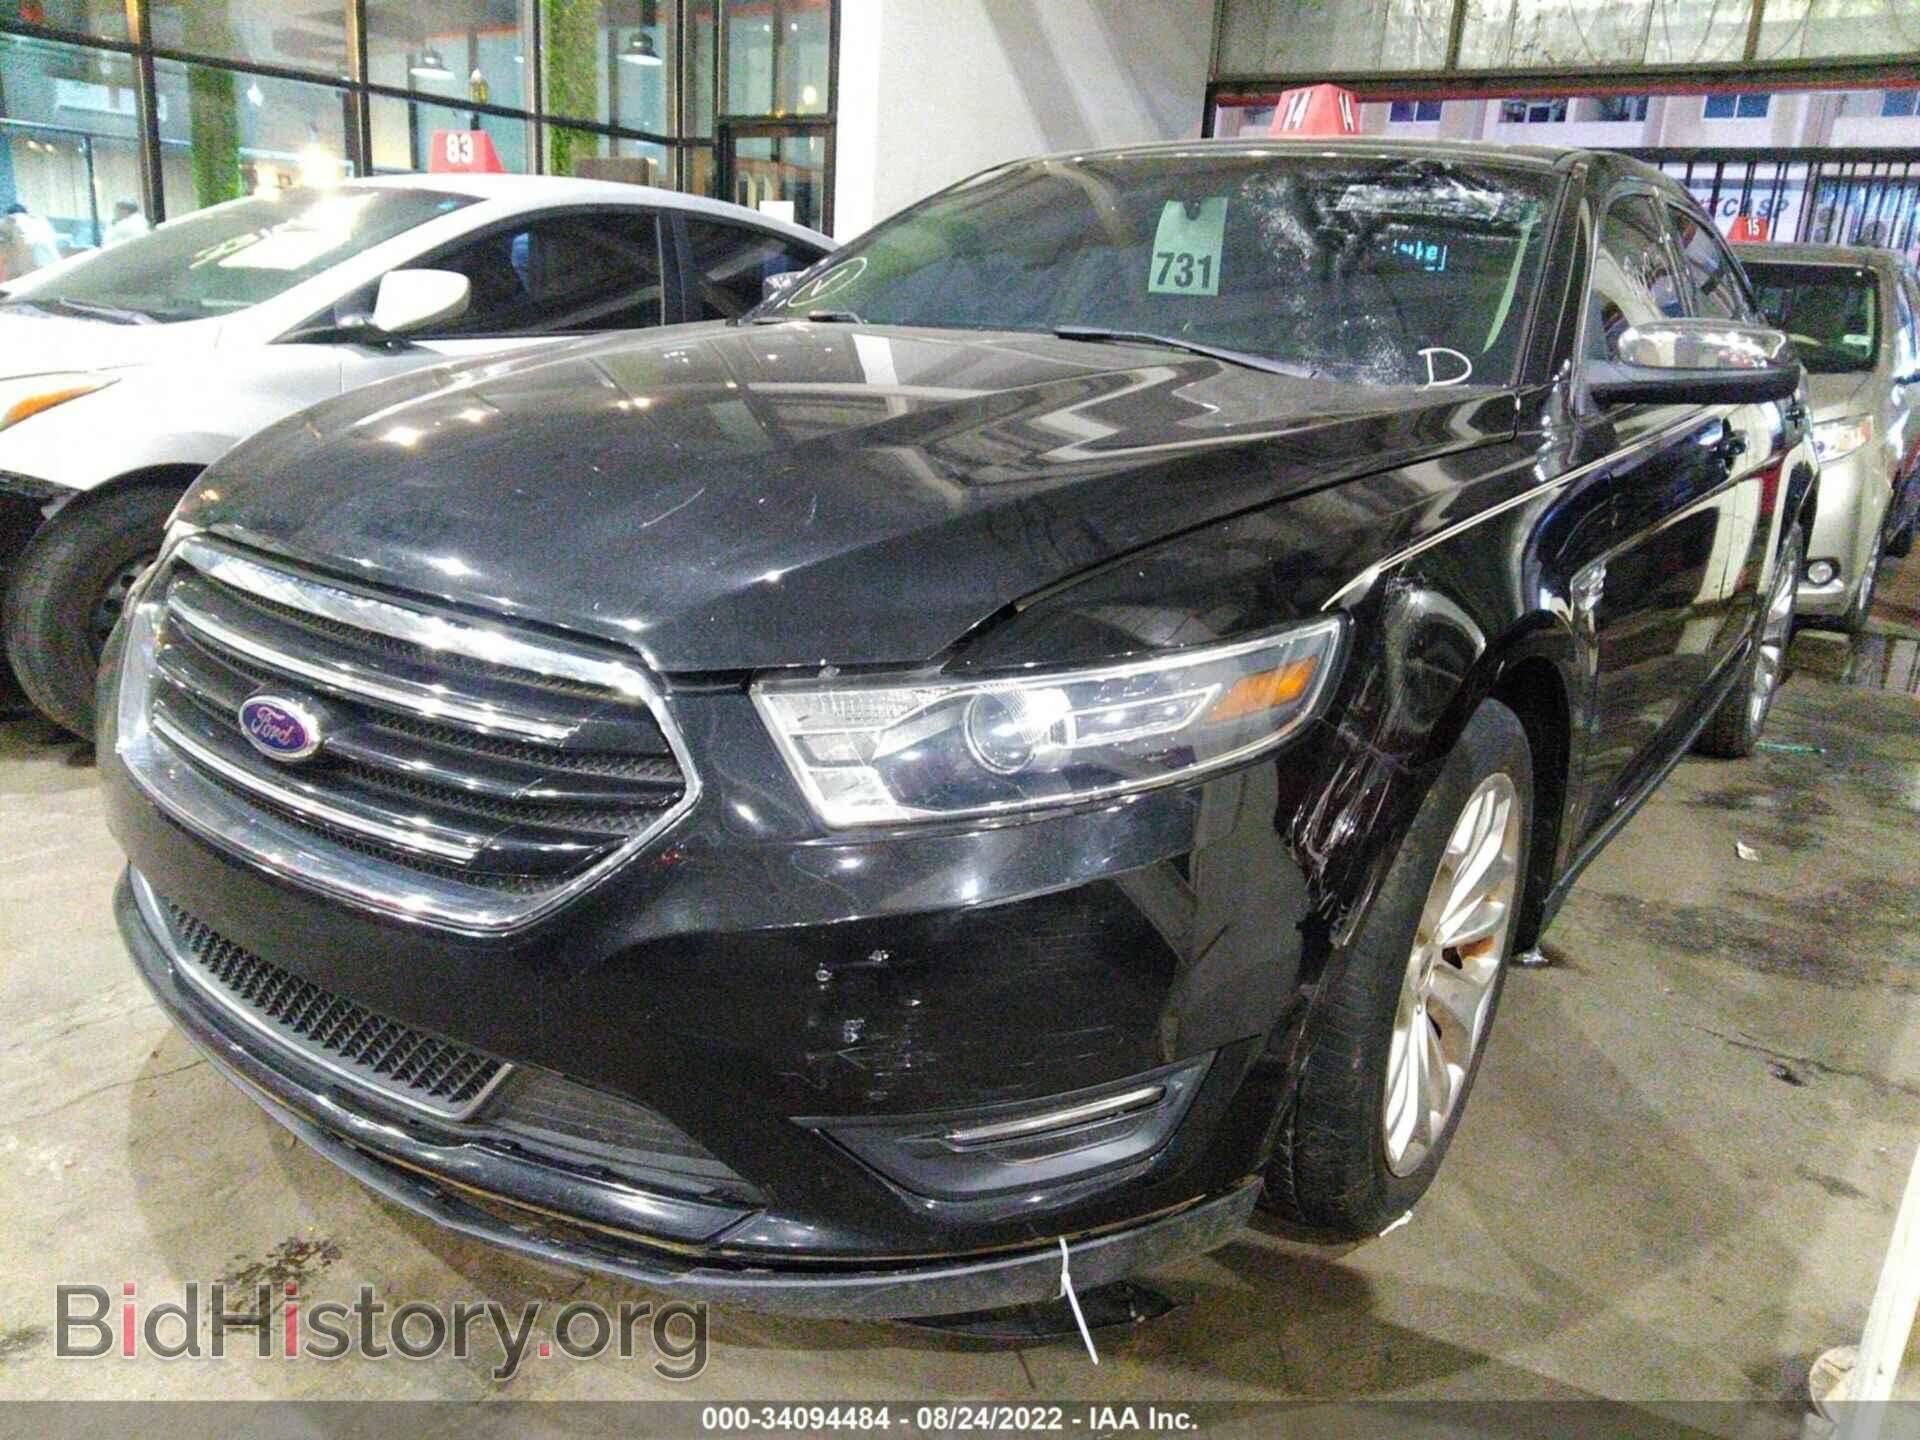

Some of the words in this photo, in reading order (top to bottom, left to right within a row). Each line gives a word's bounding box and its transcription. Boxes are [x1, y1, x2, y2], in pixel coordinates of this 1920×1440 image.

[1282, 90, 1313, 132] 14
[445, 133, 473, 164] 83
[1746, 218, 1761, 236] 15
[1156, 251, 1213, 288] 731
[1416, 346, 1473, 391] D
[250, 706, 295, 746] Ford
